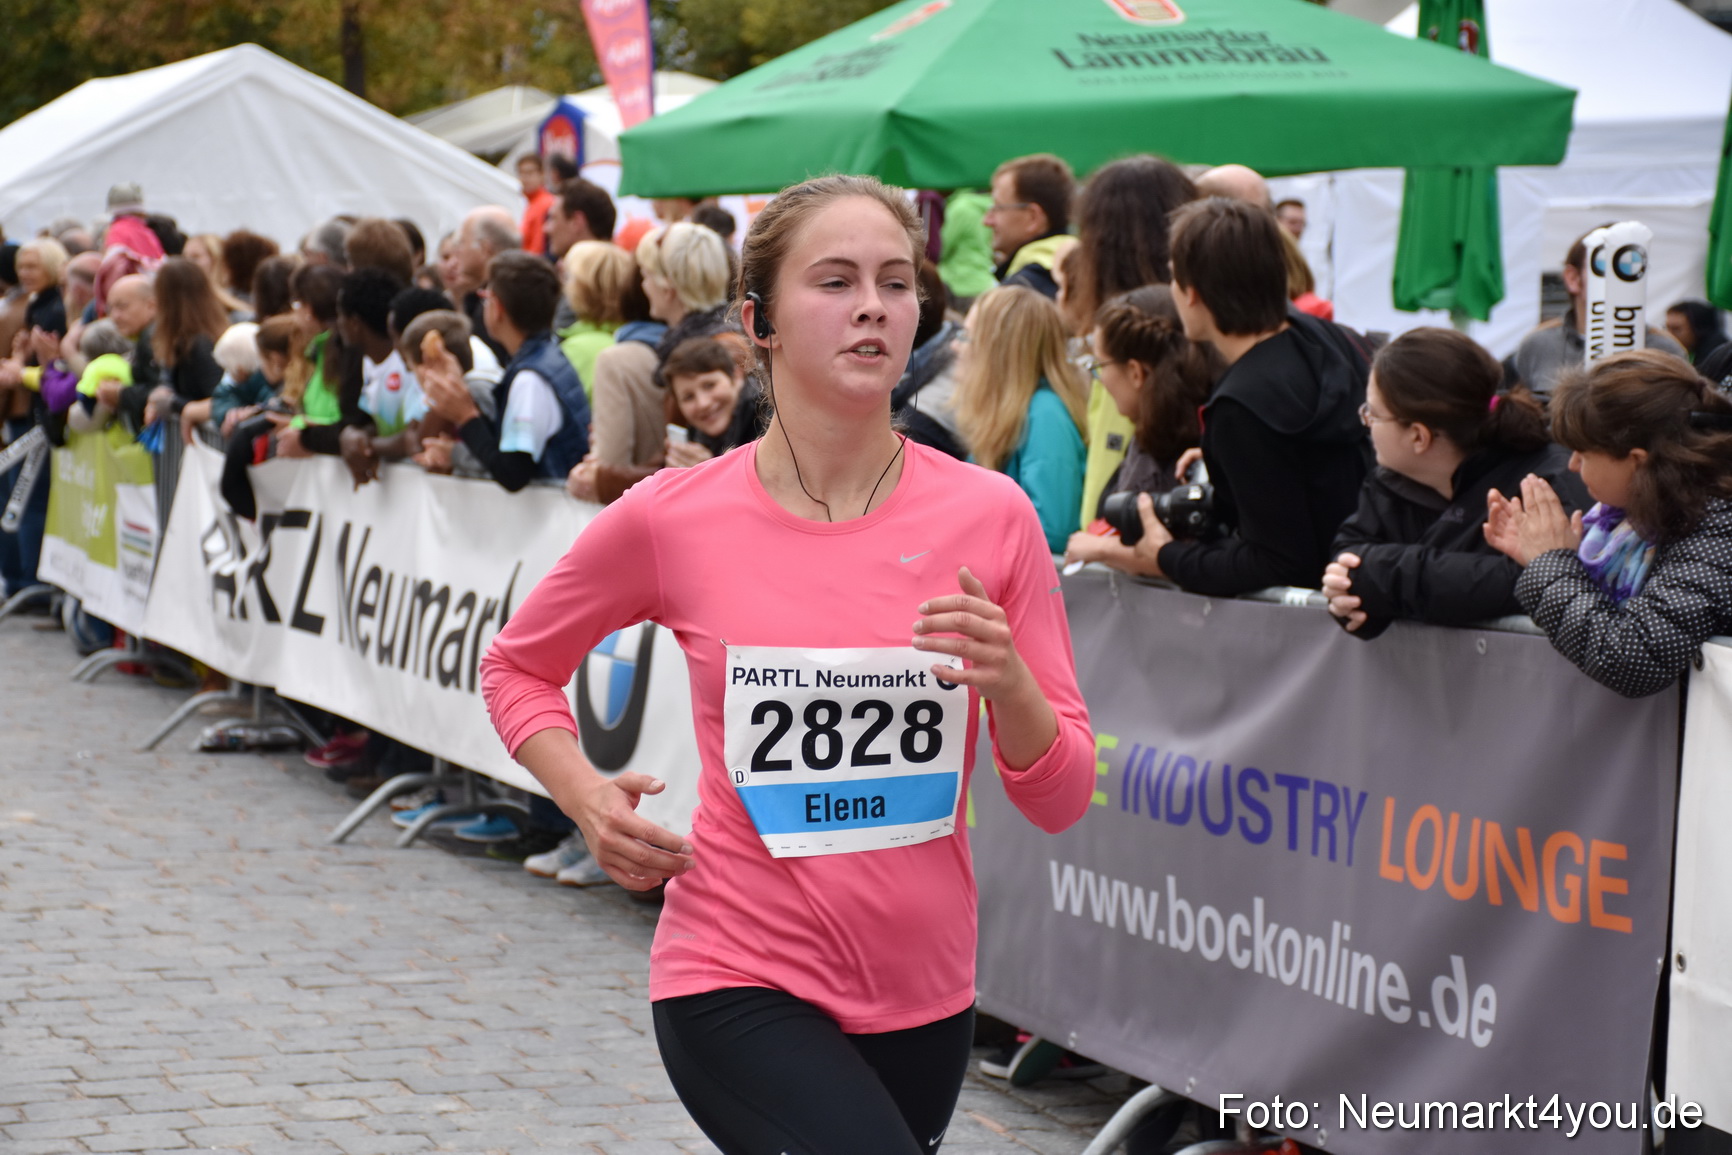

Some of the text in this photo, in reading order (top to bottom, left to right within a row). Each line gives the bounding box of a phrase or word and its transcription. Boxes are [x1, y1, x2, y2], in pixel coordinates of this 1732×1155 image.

[1052, 43, 1332, 69] Lammsbräu
[1613, 305, 1642, 354] bm
[732, 667, 927, 688] PARTL Neumarkt
[751, 699, 944, 773] 2828
[735, 770, 745, 784] D
[805, 793, 886, 824] Elena
[1121, 743, 1368, 867] INDUSTRY
[1379, 797, 1633, 934] LOUNGE
[1049, 860, 1498, 1048] www.bockonline.de
